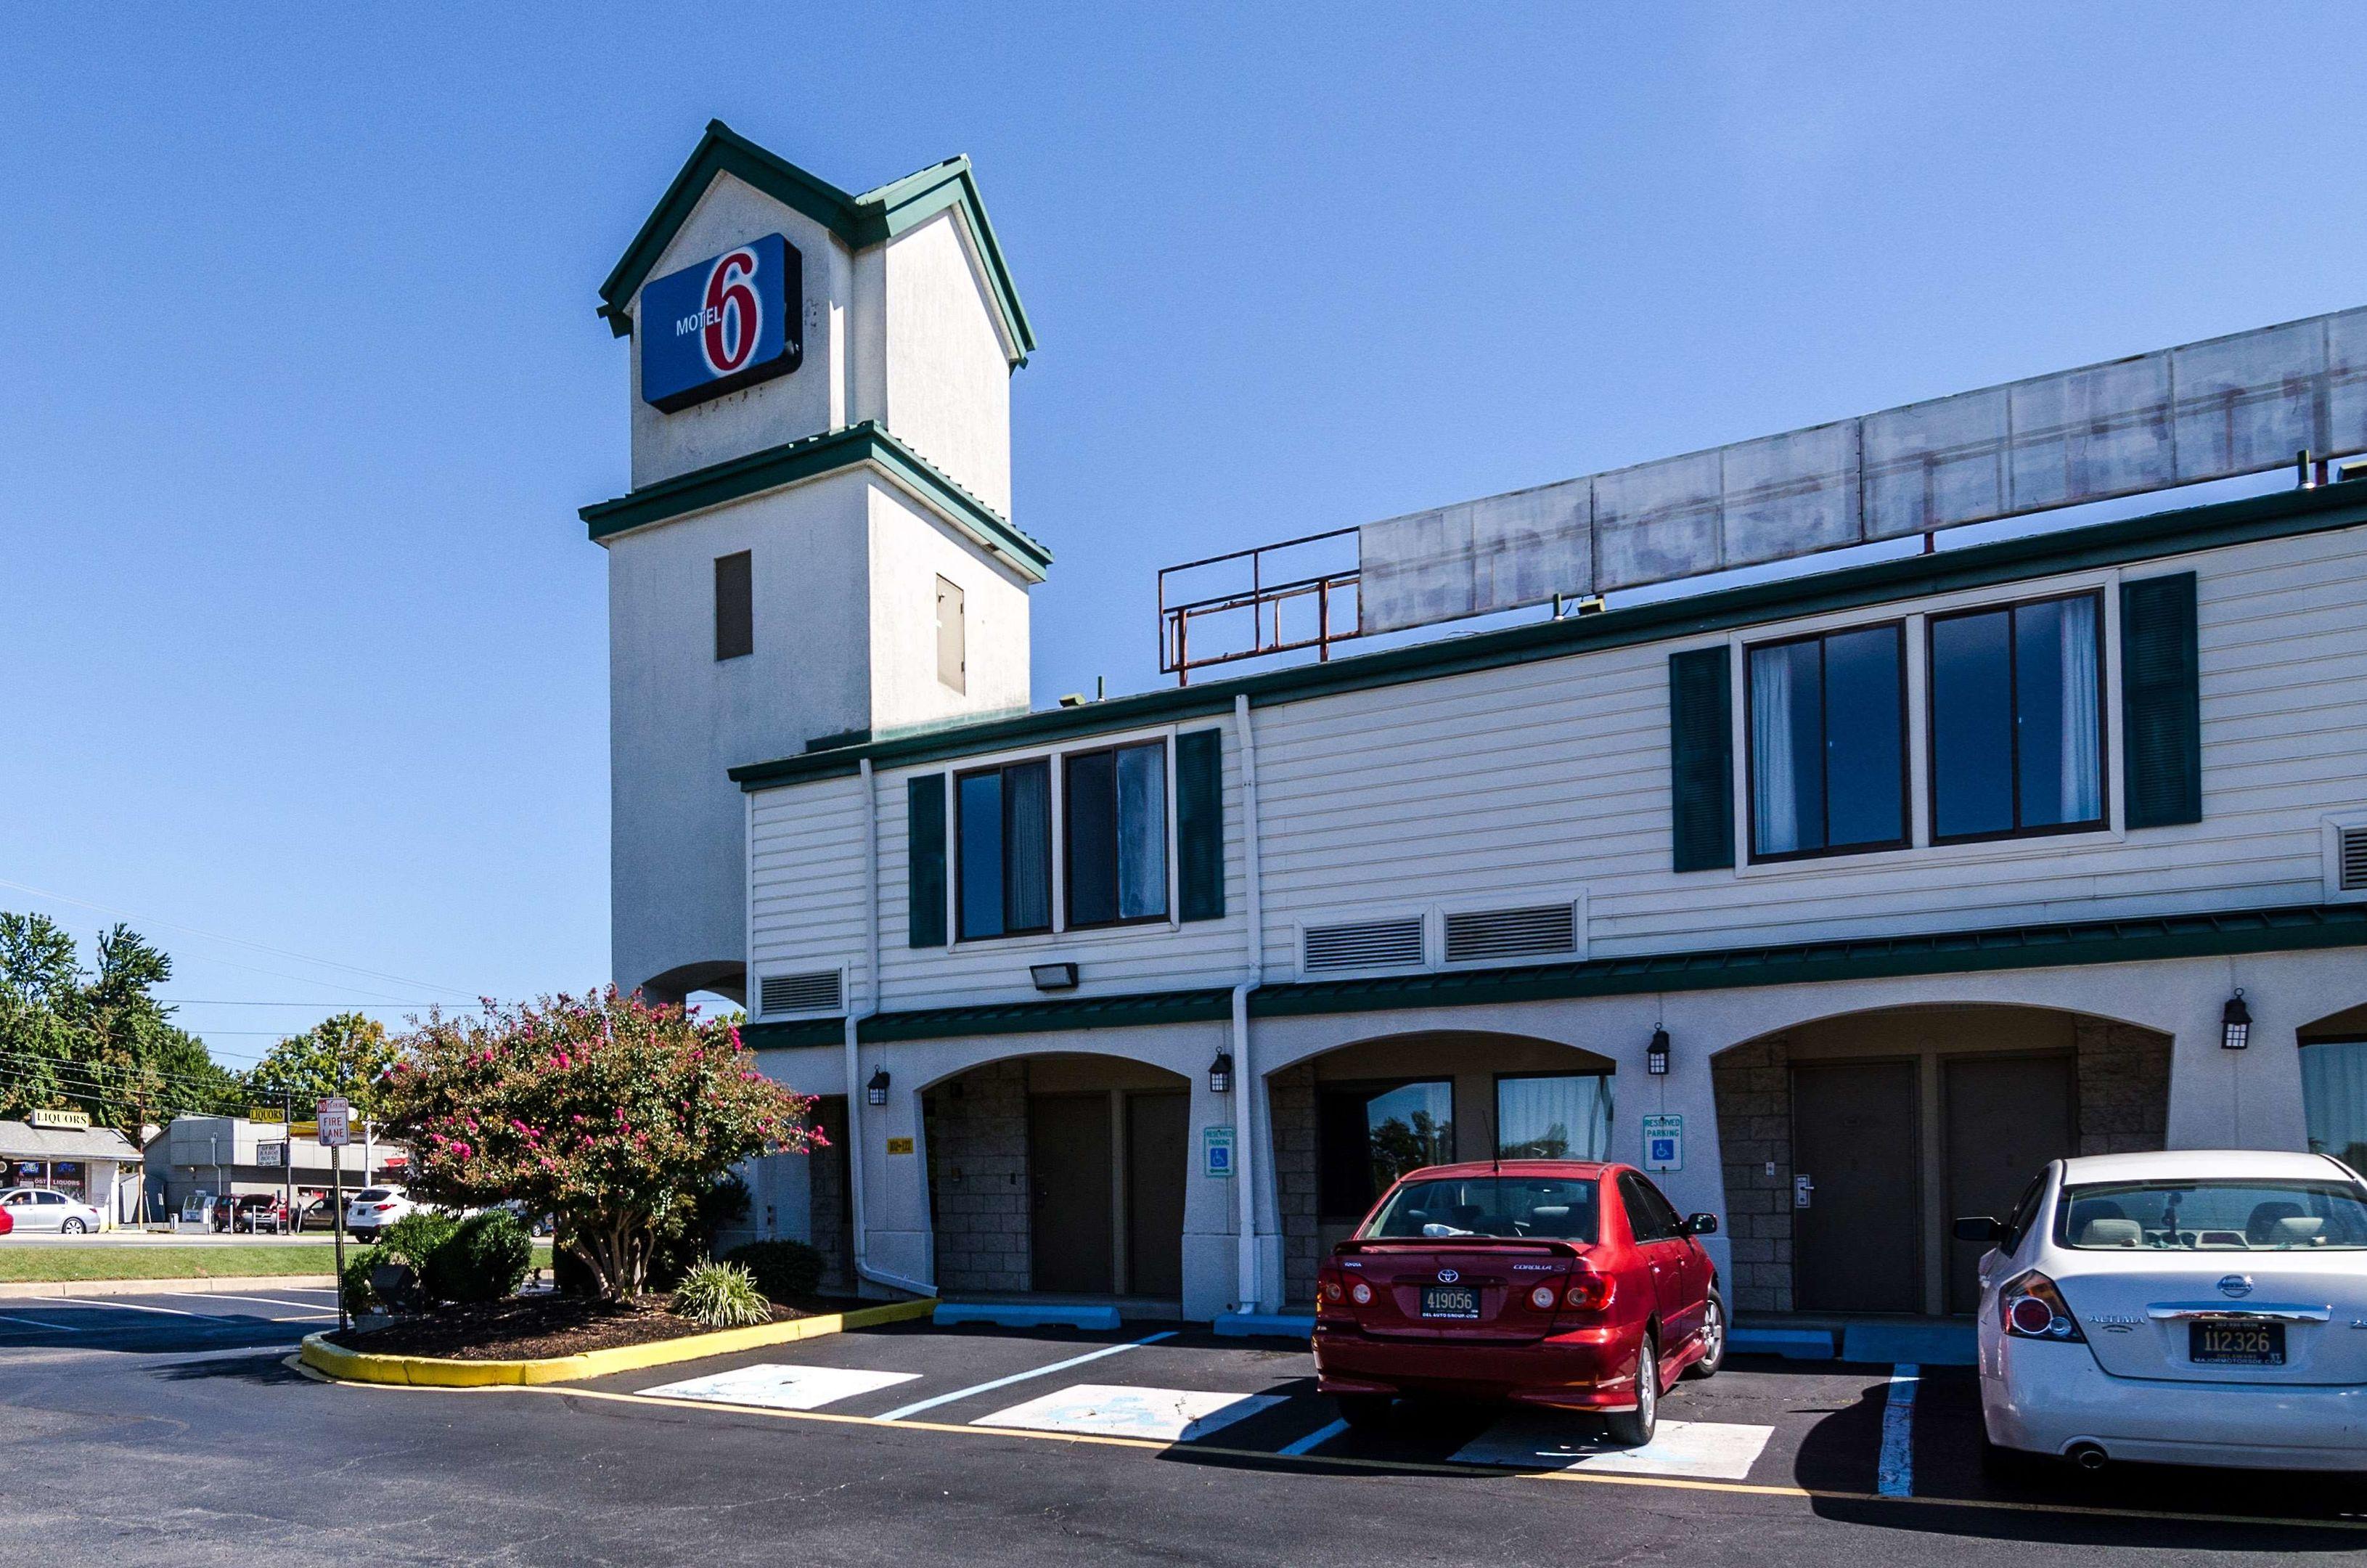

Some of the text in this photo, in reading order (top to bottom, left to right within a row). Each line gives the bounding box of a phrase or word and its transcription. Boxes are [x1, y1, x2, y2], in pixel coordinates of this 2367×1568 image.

[676, 250, 760, 373] MOTEL 6
[37, 1112, 86, 1124] LIQUORS
[251, 1109, 283, 1120] LIQUORS
[324, 1117, 342, 1127] FIRE
[322, 1129, 344, 1138] LANE
[1427, 1292, 1472, 1309] 419056
[2089, 1315, 2146, 1324] ALTIMA
[2204, 1331, 2270, 1352] 112326
